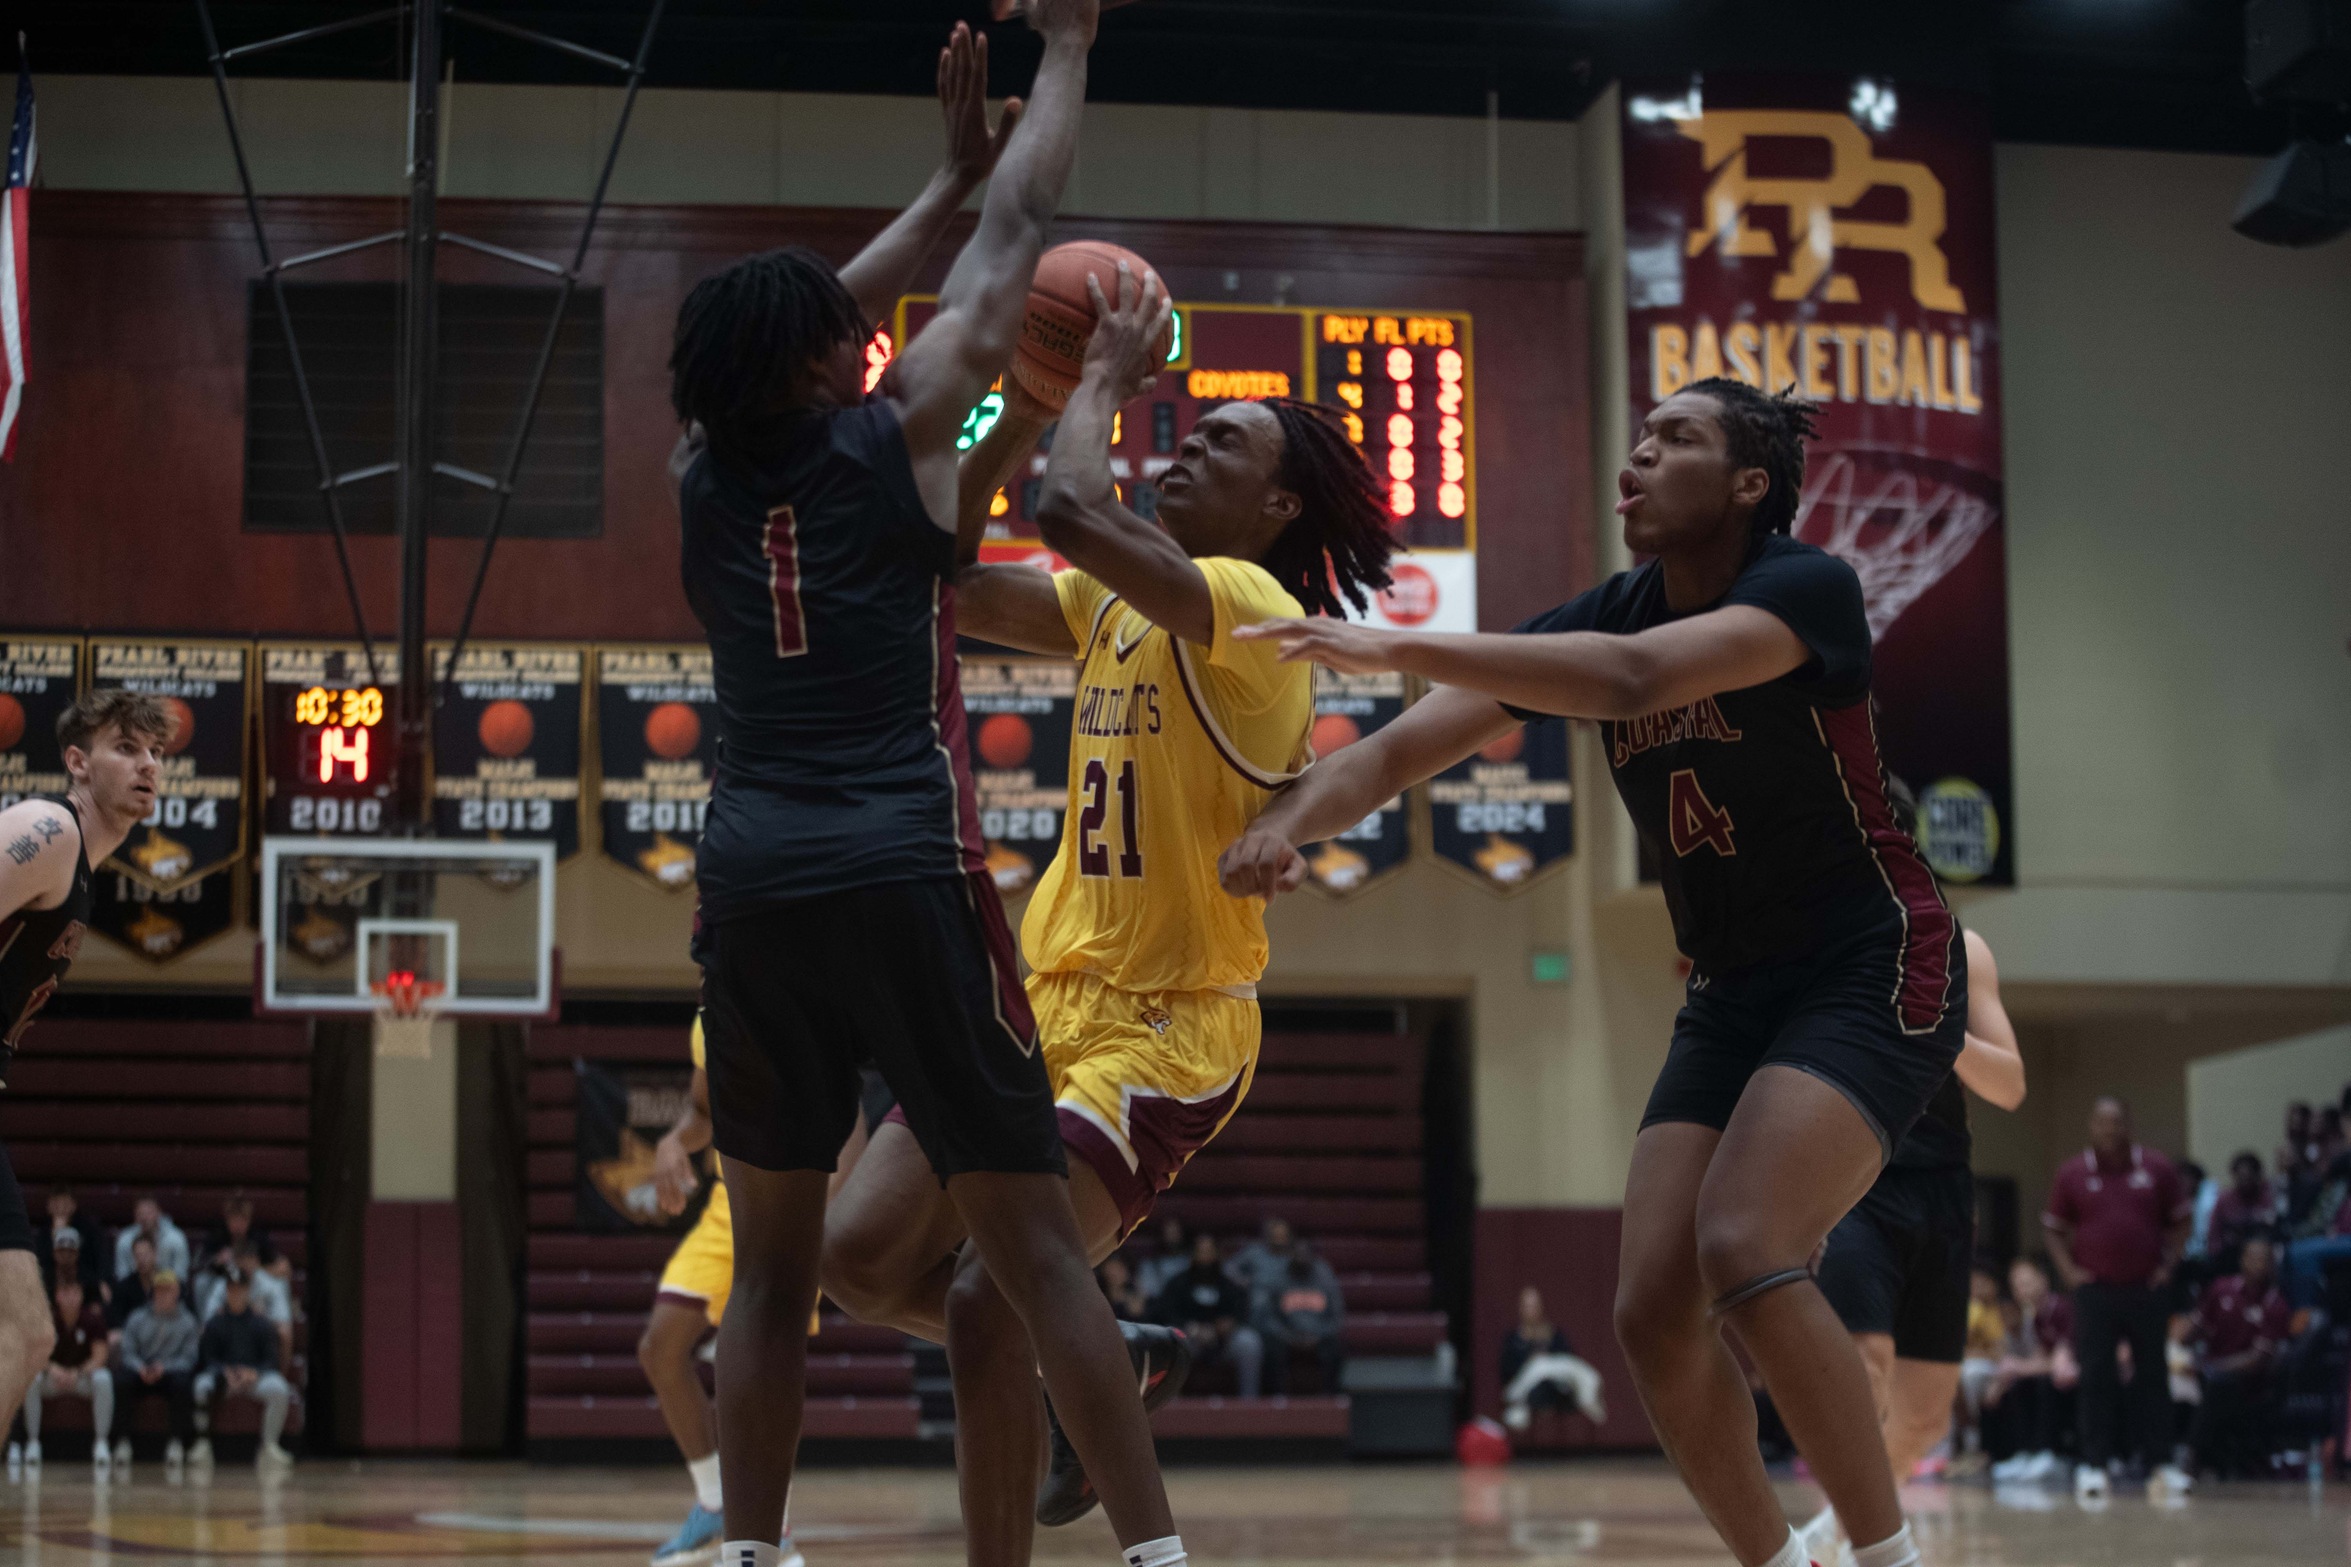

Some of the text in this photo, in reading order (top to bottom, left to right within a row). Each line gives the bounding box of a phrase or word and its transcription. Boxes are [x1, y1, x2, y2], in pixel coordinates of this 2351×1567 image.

[1373, 316, 1406, 346] FL
[1406, 318, 1455, 347] PTS
[1187, 369, 1290, 399] COYOTES
[1650, 320, 1983, 415] BASKETBALL
[760, 502, 809, 659] 1
[296, 686, 384, 728] 10:30
[319, 725, 370, 784] 14
[289, 797, 383, 833] 2010
[459, 797, 553, 832] 2013
[980, 808, 1058, 842] 020
[1079, 758, 1144, 881] 21
[1456, 803, 1546, 833] 2024
[1669, 767, 1737, 858] 4
